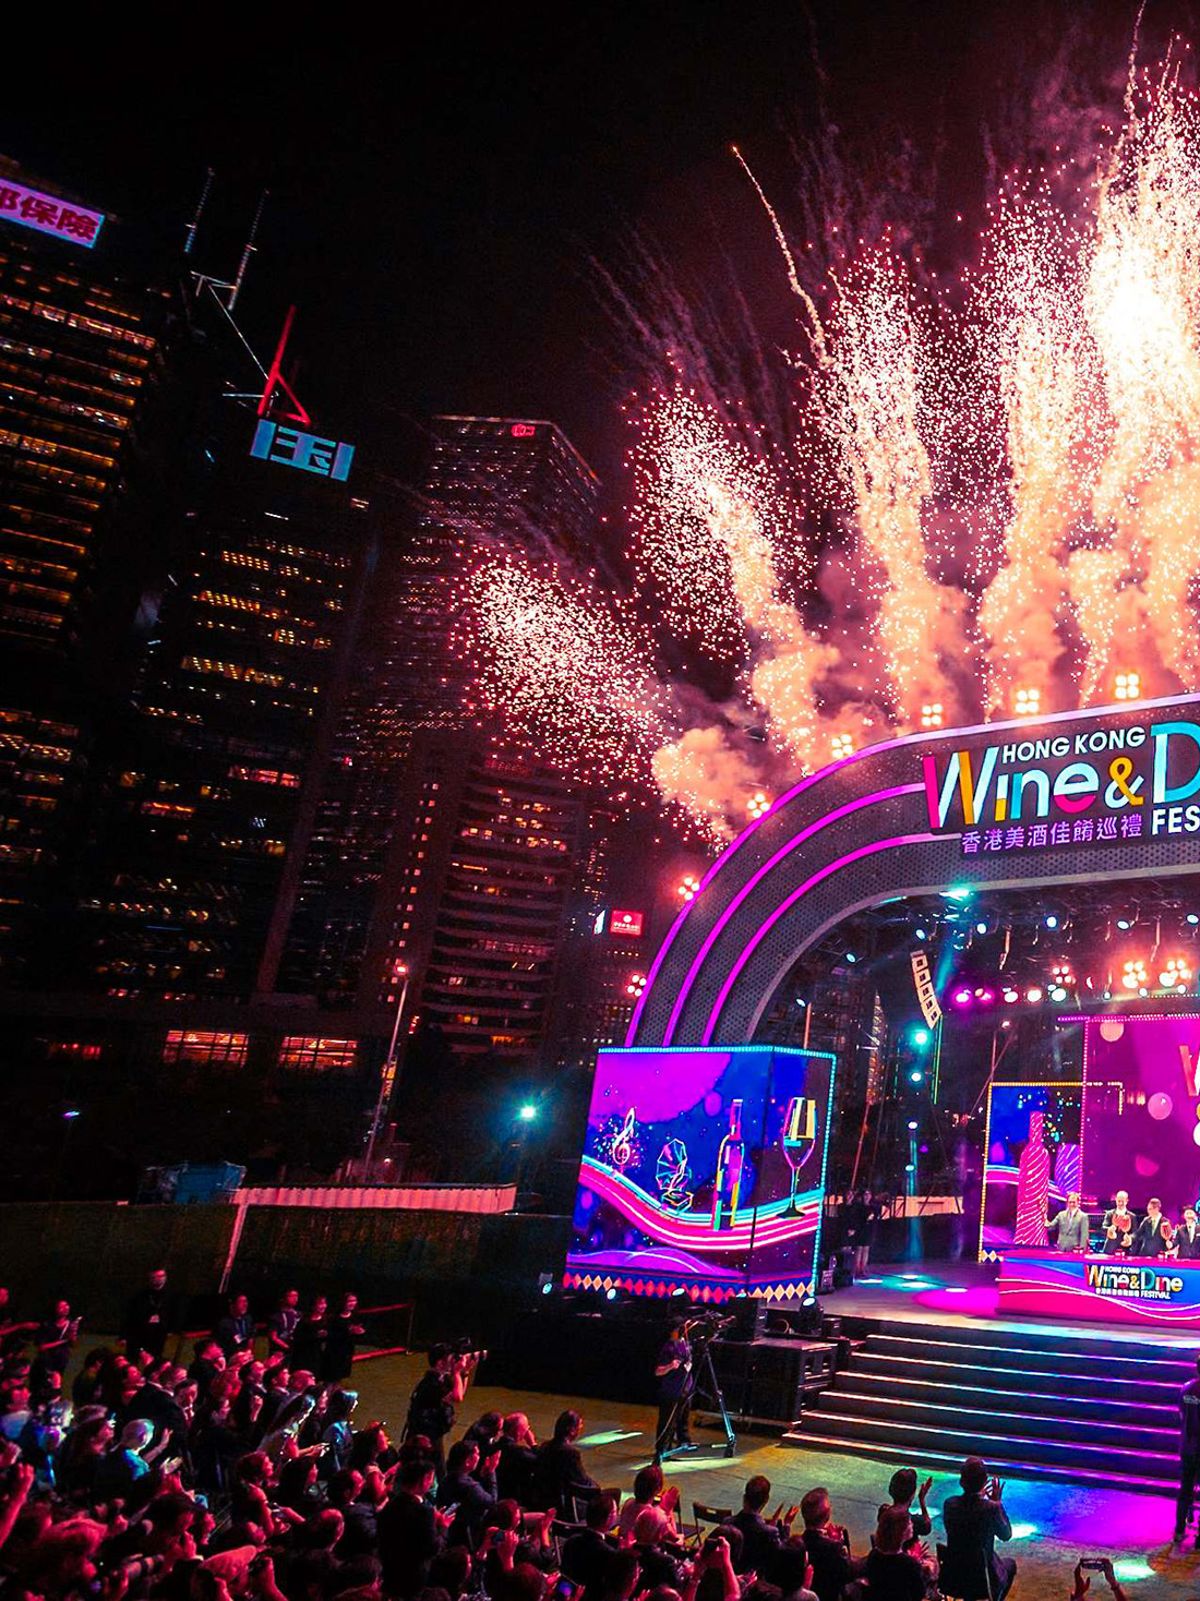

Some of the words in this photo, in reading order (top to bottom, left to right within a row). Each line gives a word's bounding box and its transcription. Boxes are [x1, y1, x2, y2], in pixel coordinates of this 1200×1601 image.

[1002, 739, 1070, 764] HONG
[1074, 726, 1146, 755] KONG
[962, 813, 1142, 854] 香港美酒佳餚巡禮
